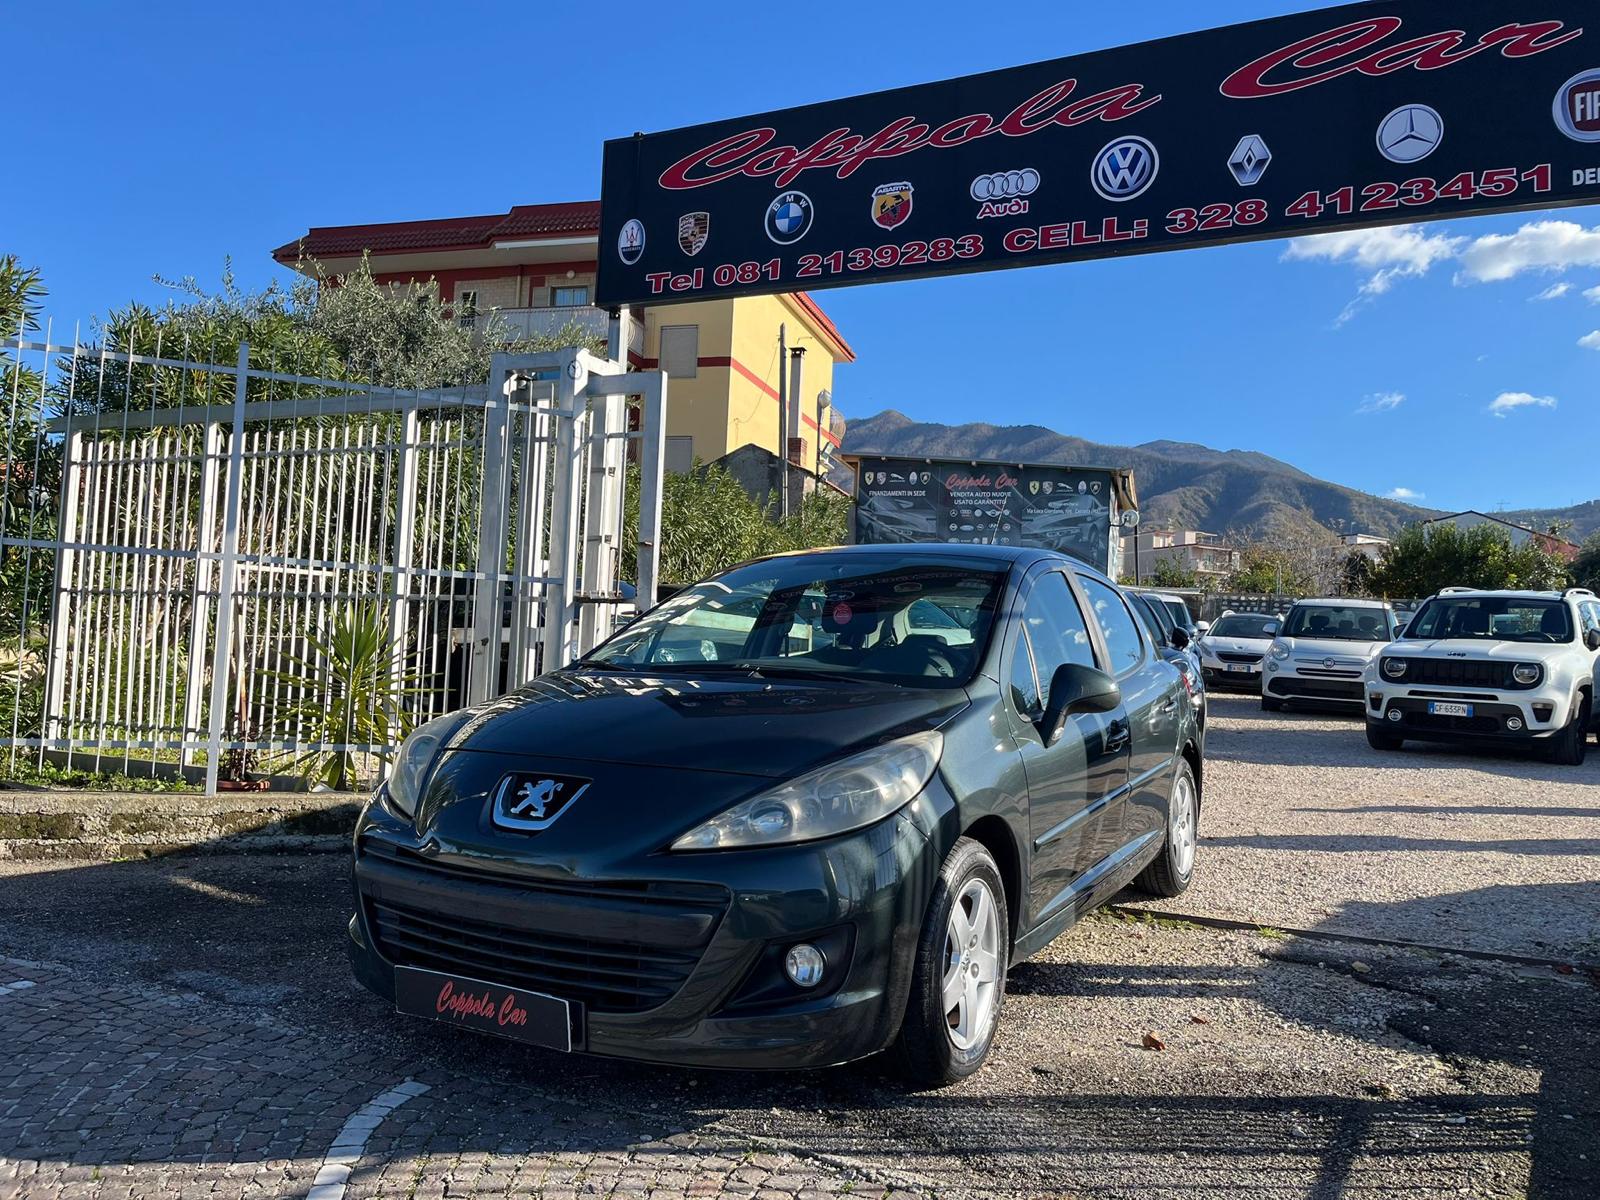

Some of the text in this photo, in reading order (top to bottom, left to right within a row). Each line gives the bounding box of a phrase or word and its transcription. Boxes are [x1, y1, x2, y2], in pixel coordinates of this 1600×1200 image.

[658, 16, 1583, 191] Coppola Car
[877, 185, 909, 194] ABARTH
[976, 199, 1030, 219] Audi
[646, 163, 1552, 294] Tel 081 2139283 CELL: 328 4123451
[945, 473, 1018, 490] Coppola Car
[436, 980, 527, 1026] Coppola Car
